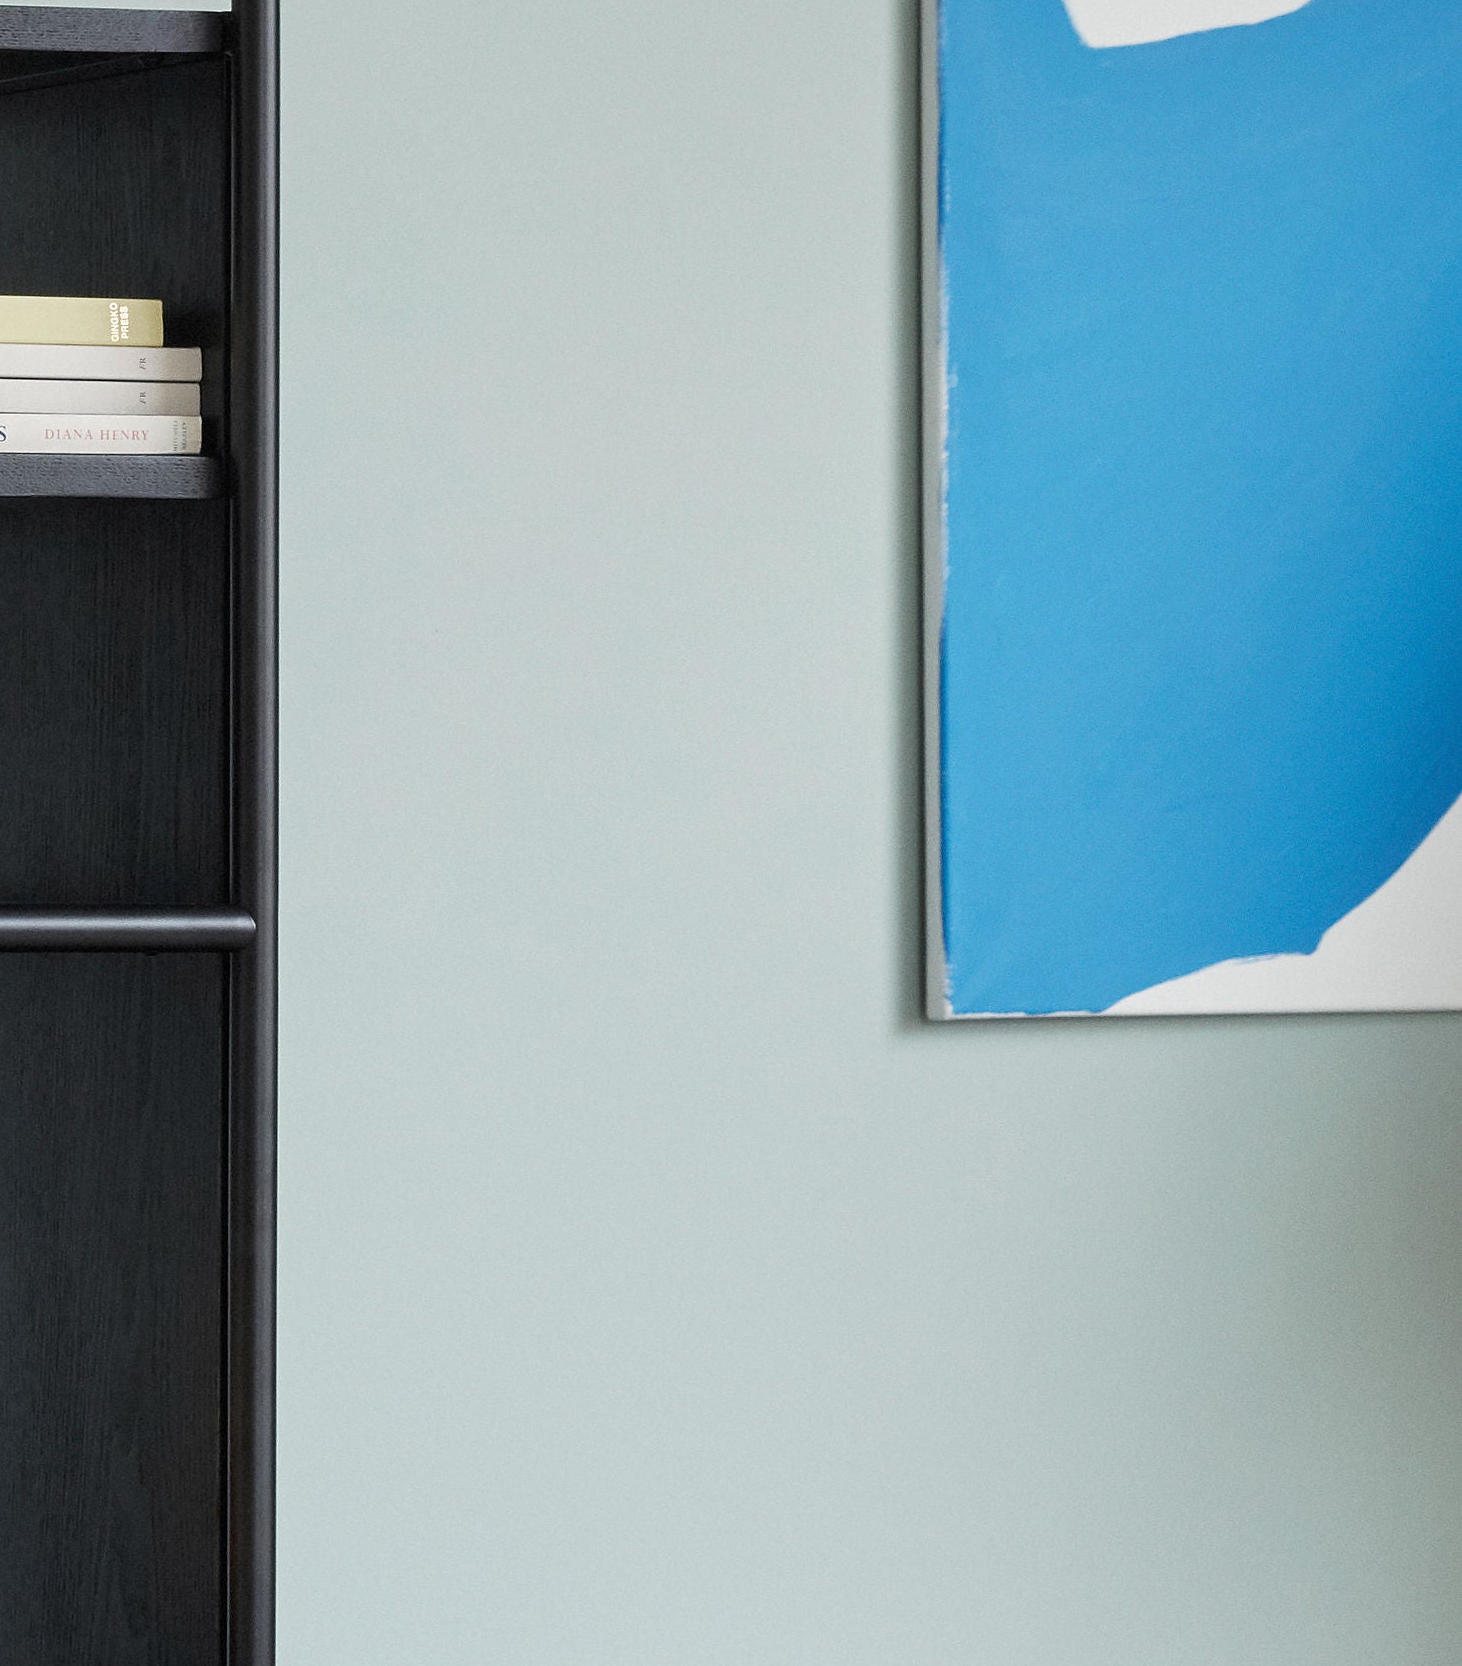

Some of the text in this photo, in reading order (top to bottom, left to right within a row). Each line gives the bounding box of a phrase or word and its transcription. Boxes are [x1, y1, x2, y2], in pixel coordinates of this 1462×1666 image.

[119, 305, 129, 339] PRESS
[44, 428, 150, 441] DIANA HENRY
